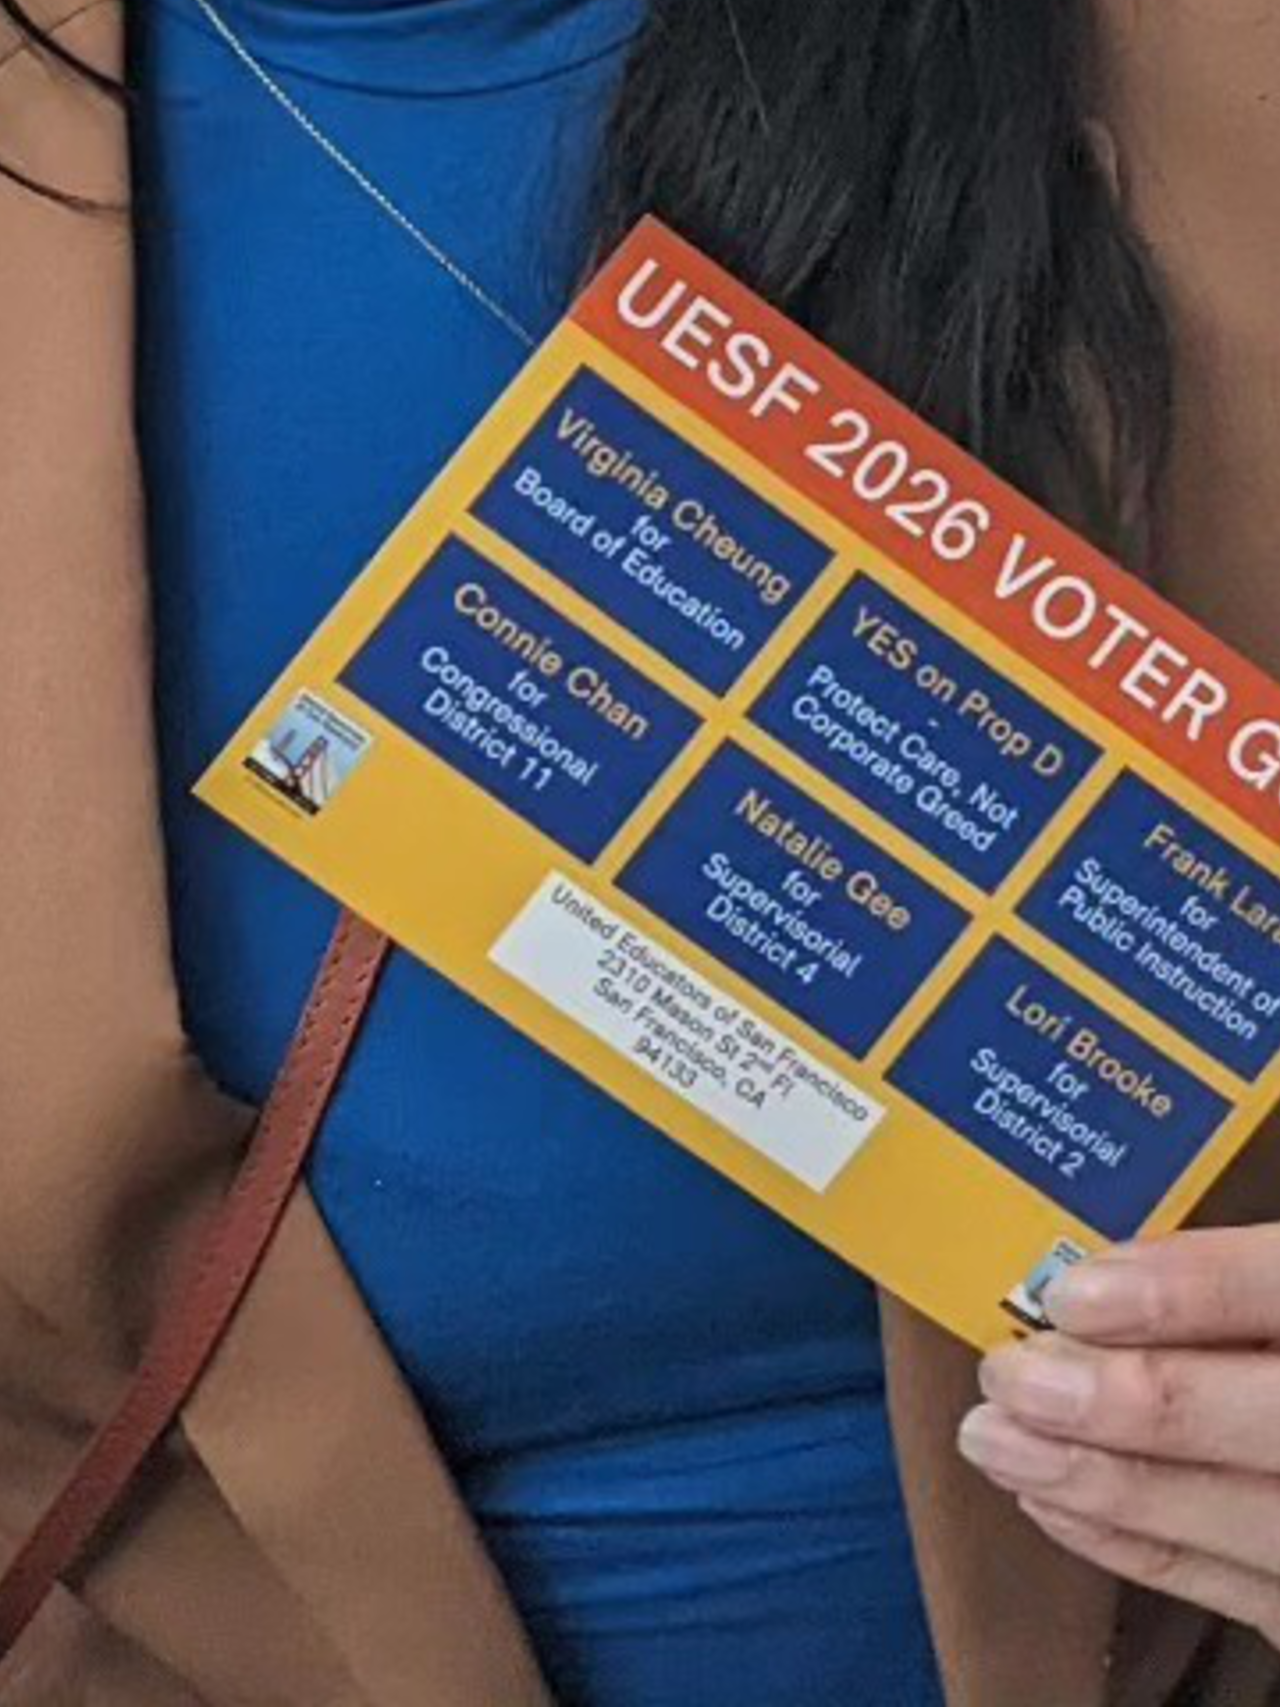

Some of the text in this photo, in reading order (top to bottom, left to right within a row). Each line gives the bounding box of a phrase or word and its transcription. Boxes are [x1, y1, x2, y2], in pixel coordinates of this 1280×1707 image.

[514, 466, 746, 651] Board of Education
[556, 407, 791, 605] Virginia Cheung
[616, 258, 820, 418] UESF
[803, 409, 990, 561] 2026
[994, 533, 1228, 741] VOTER
[630, 515, 672, 551] for
[421, 646, 600, 786] Congressional
[453, 583, 649, 739] Connie Chan
[507, 669, 548, 709] for
[852, 605, 1065, 776] YES on Prop D
[422, 687, 517, 768] District
[519, 757, 553, 790] 11
[792, 695, 998, 852] Corporate Greed
[806, 664, 1018, 831] Protect Care, Not
[701, 852, 863, 979] Supervisorial
[734, 788, 912, 930] Natalie Gee
[780, 869, 822, 908] for
[1142, 822, 1231, 901] Frank
[1179, 895, 1219, 931] for
[705, 894, 821, 985] District 4
[1057, 885, 1260, 1041] Public Instruction
[1073, 856, 1255, 1000] Superintendent
[549, 883, 871, 1124] United Educators of San Francisco
[591, 975, 770, 1111] San Francisco, CA
[596, 948, 652, 996] 2310
[648, 985, 717, 1046] Mason
[713, 1031, 744, 1063] St
[631, 1033, 700, 1092] 94133
[1004, 984, 1173, 1118] Lori Brooke
[970, 1047, 1127, 1168] Supervisorial
[972, 1088, 1086, 1179] District 2
[1046, 1061, 1090, 1101] for
